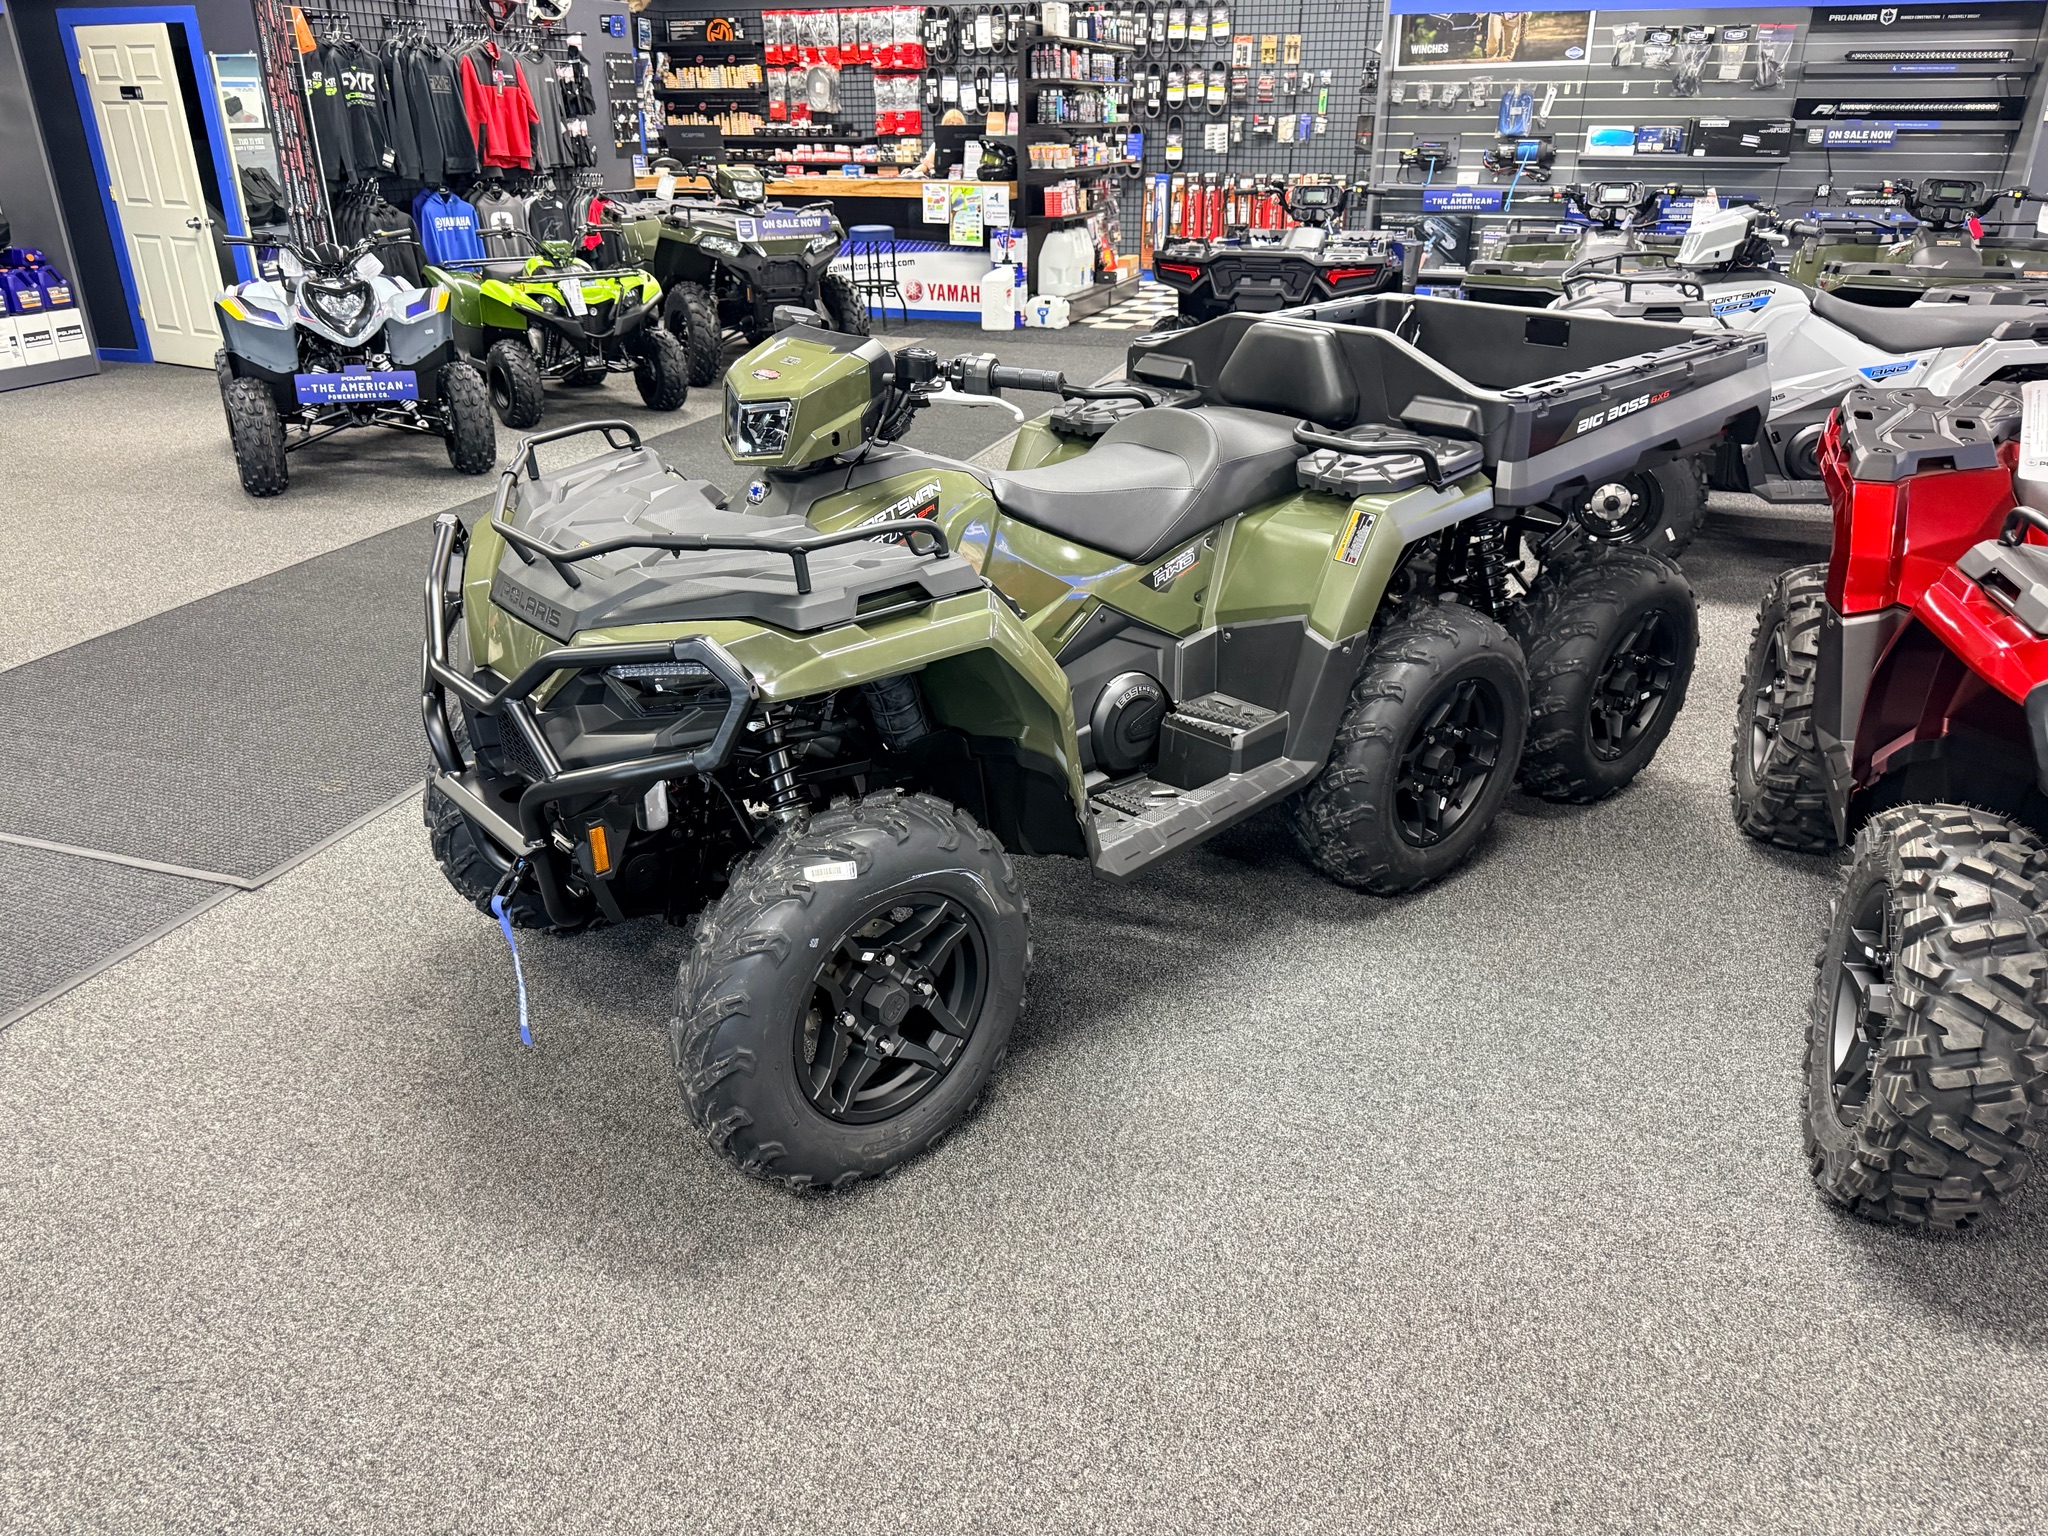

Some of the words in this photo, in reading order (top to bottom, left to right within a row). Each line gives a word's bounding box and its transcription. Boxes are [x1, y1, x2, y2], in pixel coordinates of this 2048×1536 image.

[1828, 14, 1847, 22] PRO
[1847, 13, 1878, 21] ARMOR
[1410, 43, 1449, 55] WINCHES
[1828, 131, 1843, 139] ON
[1844, 131, 1869, 139] SALE
[1870, 131, 1894, 139] NOW
[1450, 197, 1493, 205] AMERICAN
[442, 216, 471, 228] YAMAHA
[762, 219, 776, 229] ON
[776, 218, 800, 229] SALE
[800, 217, 821, 228] NOW
[927, 283, 980, 303] YAMAH
[1708, 287, 1777, 305] PORTSMAN
[1713, 300, 1753, 313] 450
[1871, 364, 1910, 377] AWD
[310, 384, 335, 393] THE
[340, 381, 404, 392] AMERICAN
[1576, 411, 1605, 434] BIG
[1606, 393, 1650, 422] BOSS
[1154, 552, 1195, 588] AWD
[500, 581, 561, 628] POLARIS
